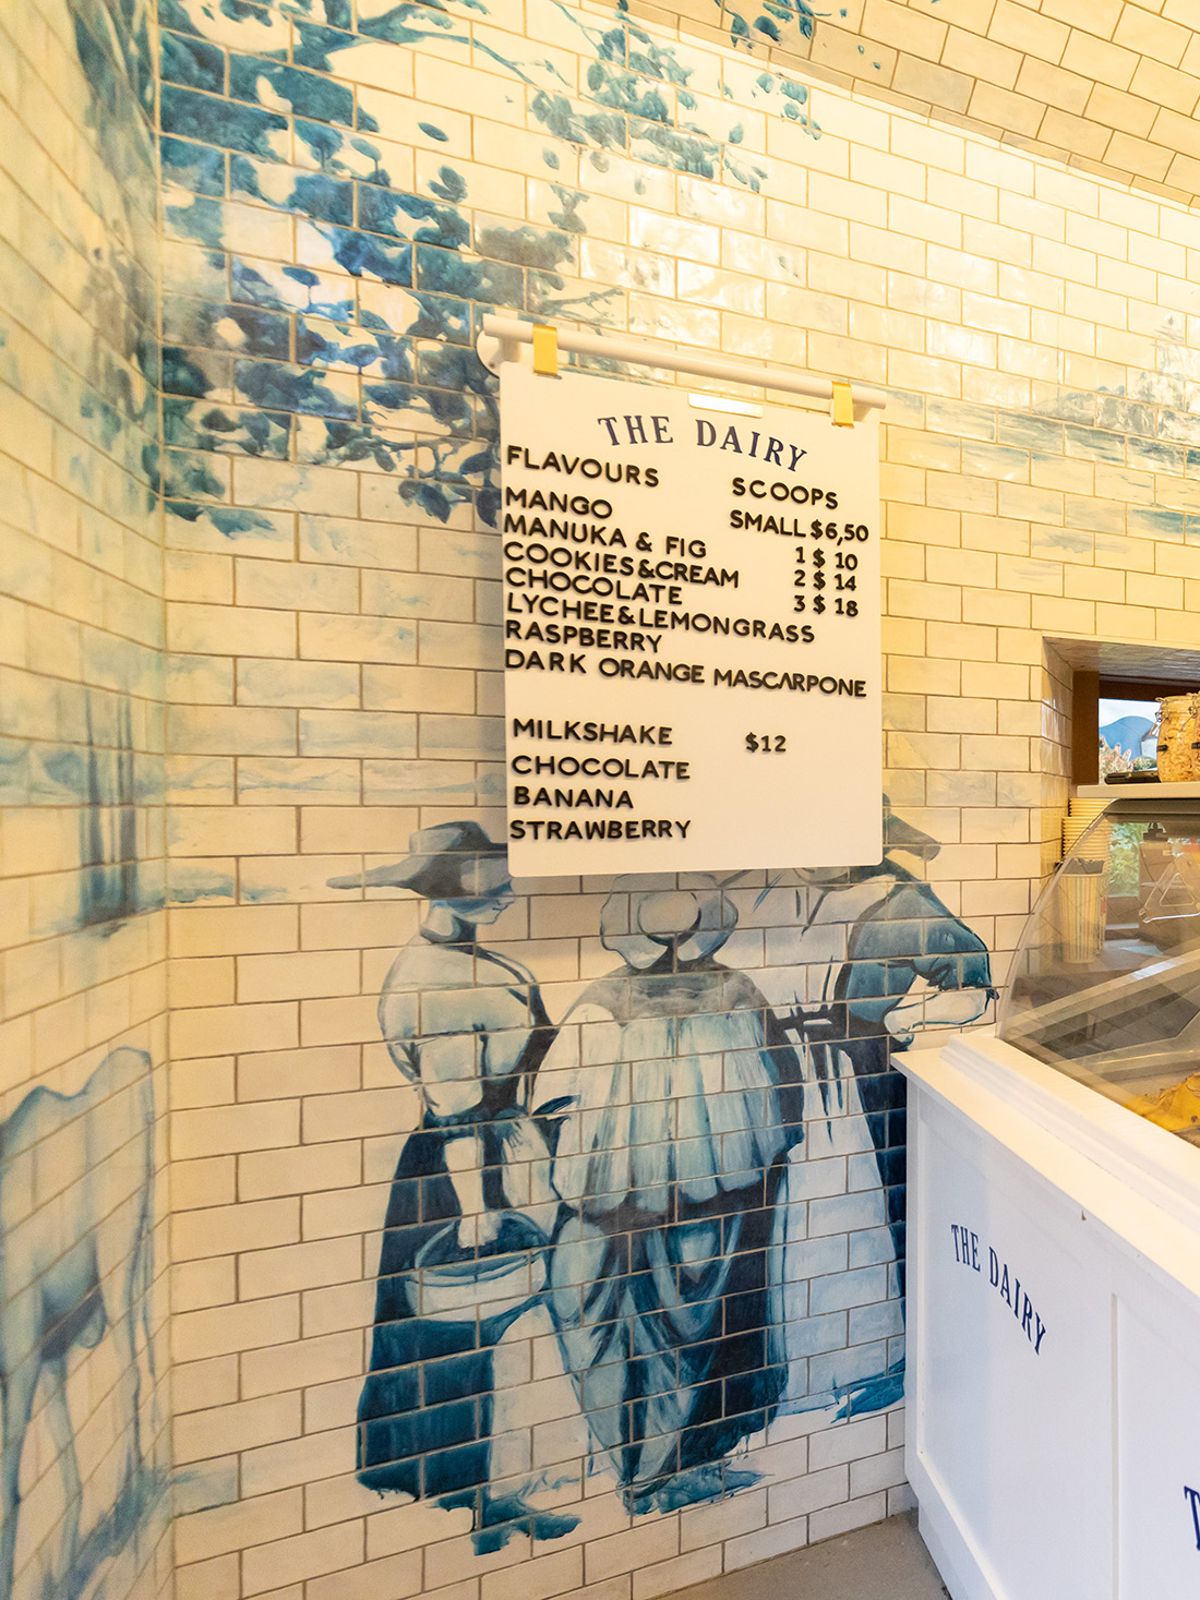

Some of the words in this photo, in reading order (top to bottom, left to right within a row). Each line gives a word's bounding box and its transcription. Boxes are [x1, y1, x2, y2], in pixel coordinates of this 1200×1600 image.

[597, 415, 674, 446] THE
[696, 419, 808, 472] DAIRY
[507, 445, 660, 487] FLAVOURS
[506, 487, 613, 518] MANGO
[732, 477, 839, 510] SCOOPS
[504, 513, 626, 549] MANUKA
[635, 532, 653, 552] &
[666, 536, 707, 558] FIG
[730, 510, 806, 538] SMALL
[810, 519, 869, 546] $6,50
[795, 547, 805, 565] 1
[813, 548, 826, 567] $
[836, 552, 858, 571] 10
[506, 567, 683, 605] CHOCOLATE
[794, 570, 805, 587] 2
[813, 572, 826, 591] $
[835, 573, 857, 592] 14
[794, 595, 805, 612] 3
[813, 595, 826, 614] $
[835, 598, 859, 617] 18
[506, 619, 662, 653] RASPBERRY
[505, 649, 586, 674] DARK
[599, 657, 705, 684] ORANGE
[714, 668, 867, 697] MASCARPONE
[512, 718, 673, 745] MILKSHAKE
[745, 733, 787, 754] $12
[511, 755, 691, 780] CHOCOLATE
[513, 786, 634, 809] BANANA
[510, 819, 691, 841] STRAWBERRY
[951, 1224, 981, 1272] THE
[988, 1246, 1047, 1355] DAIRY
